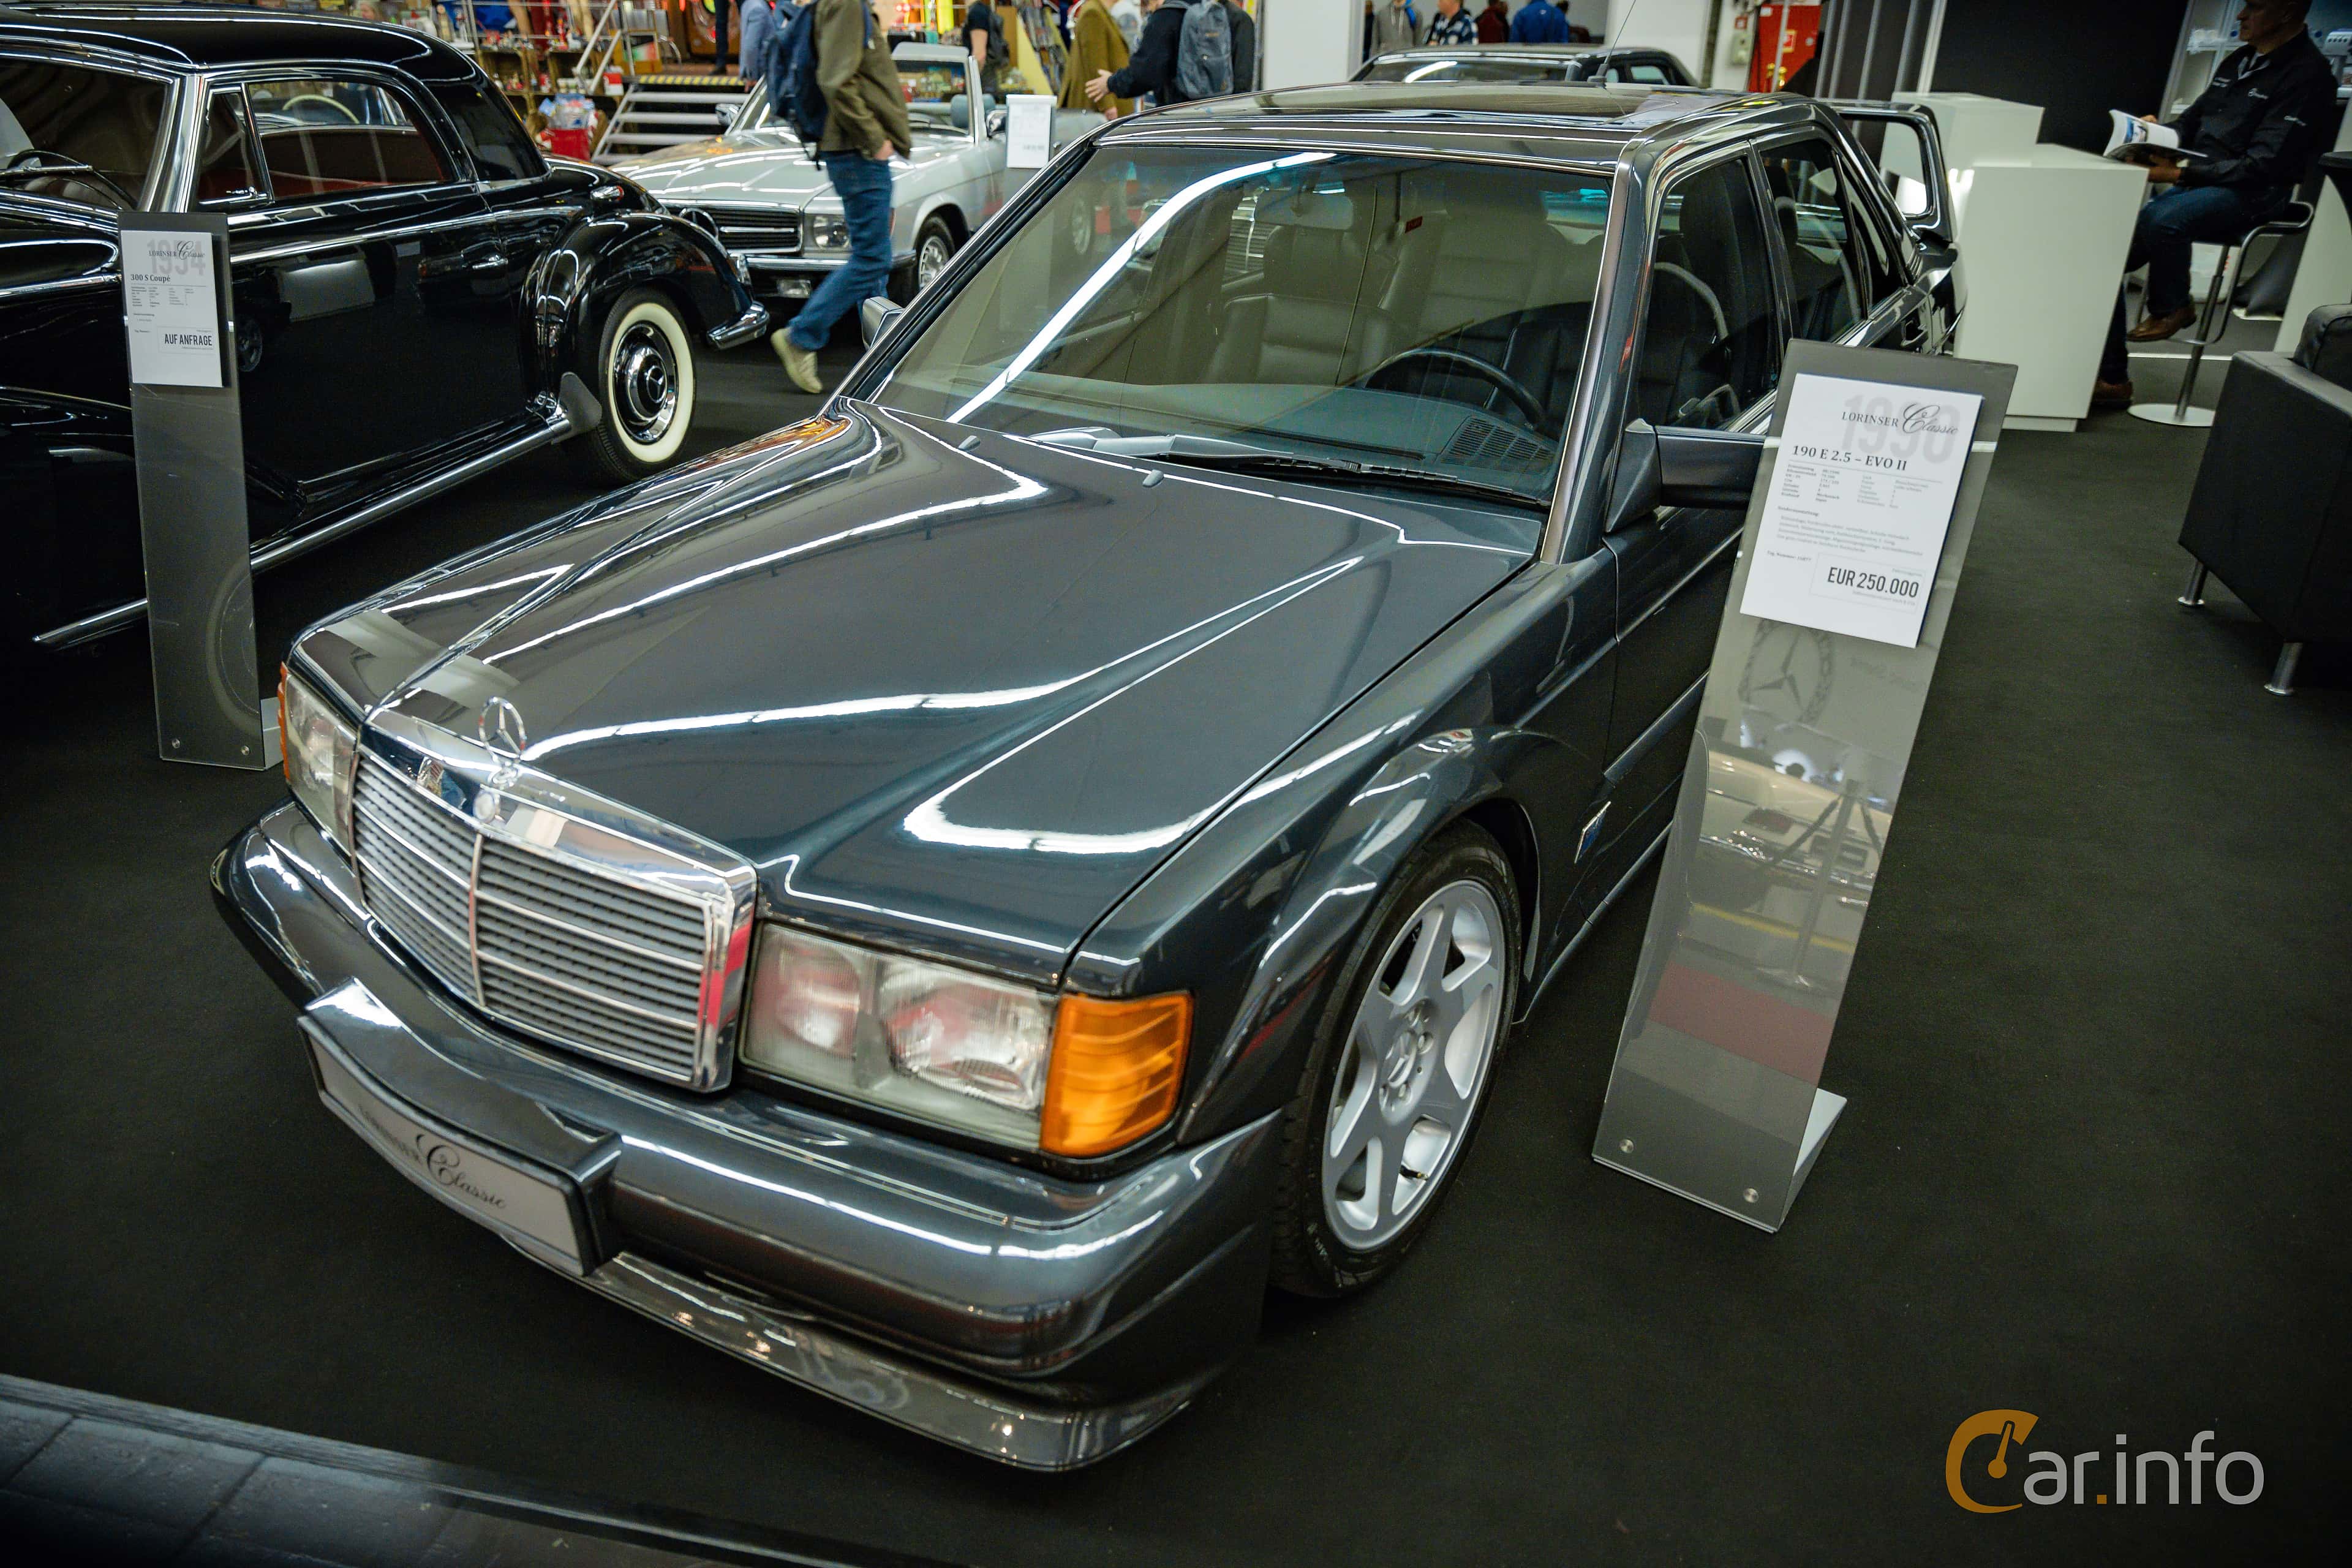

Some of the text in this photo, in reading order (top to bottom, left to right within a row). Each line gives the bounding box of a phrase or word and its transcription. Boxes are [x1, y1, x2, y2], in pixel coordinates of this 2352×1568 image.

[150, 274, 171, 284] Coupé
[164, 333, 213, 346] AUF ANFRAGE
[1842, 402, 1959, 434] LORINSER Classic
[1842, 395, 1960, 464] 1990
[1793, 445, 1817, 458] 190
[1820, 449, 1828, 459] E
[1831, 450, 1852, 463] 2.5
[1865, 455, 1893, 469] EVO
[1897, 459, 1907, 471] II
[1827, 567, 1920, 598] EUR 250.000
[416, 1134, 507, 1209] Classic
